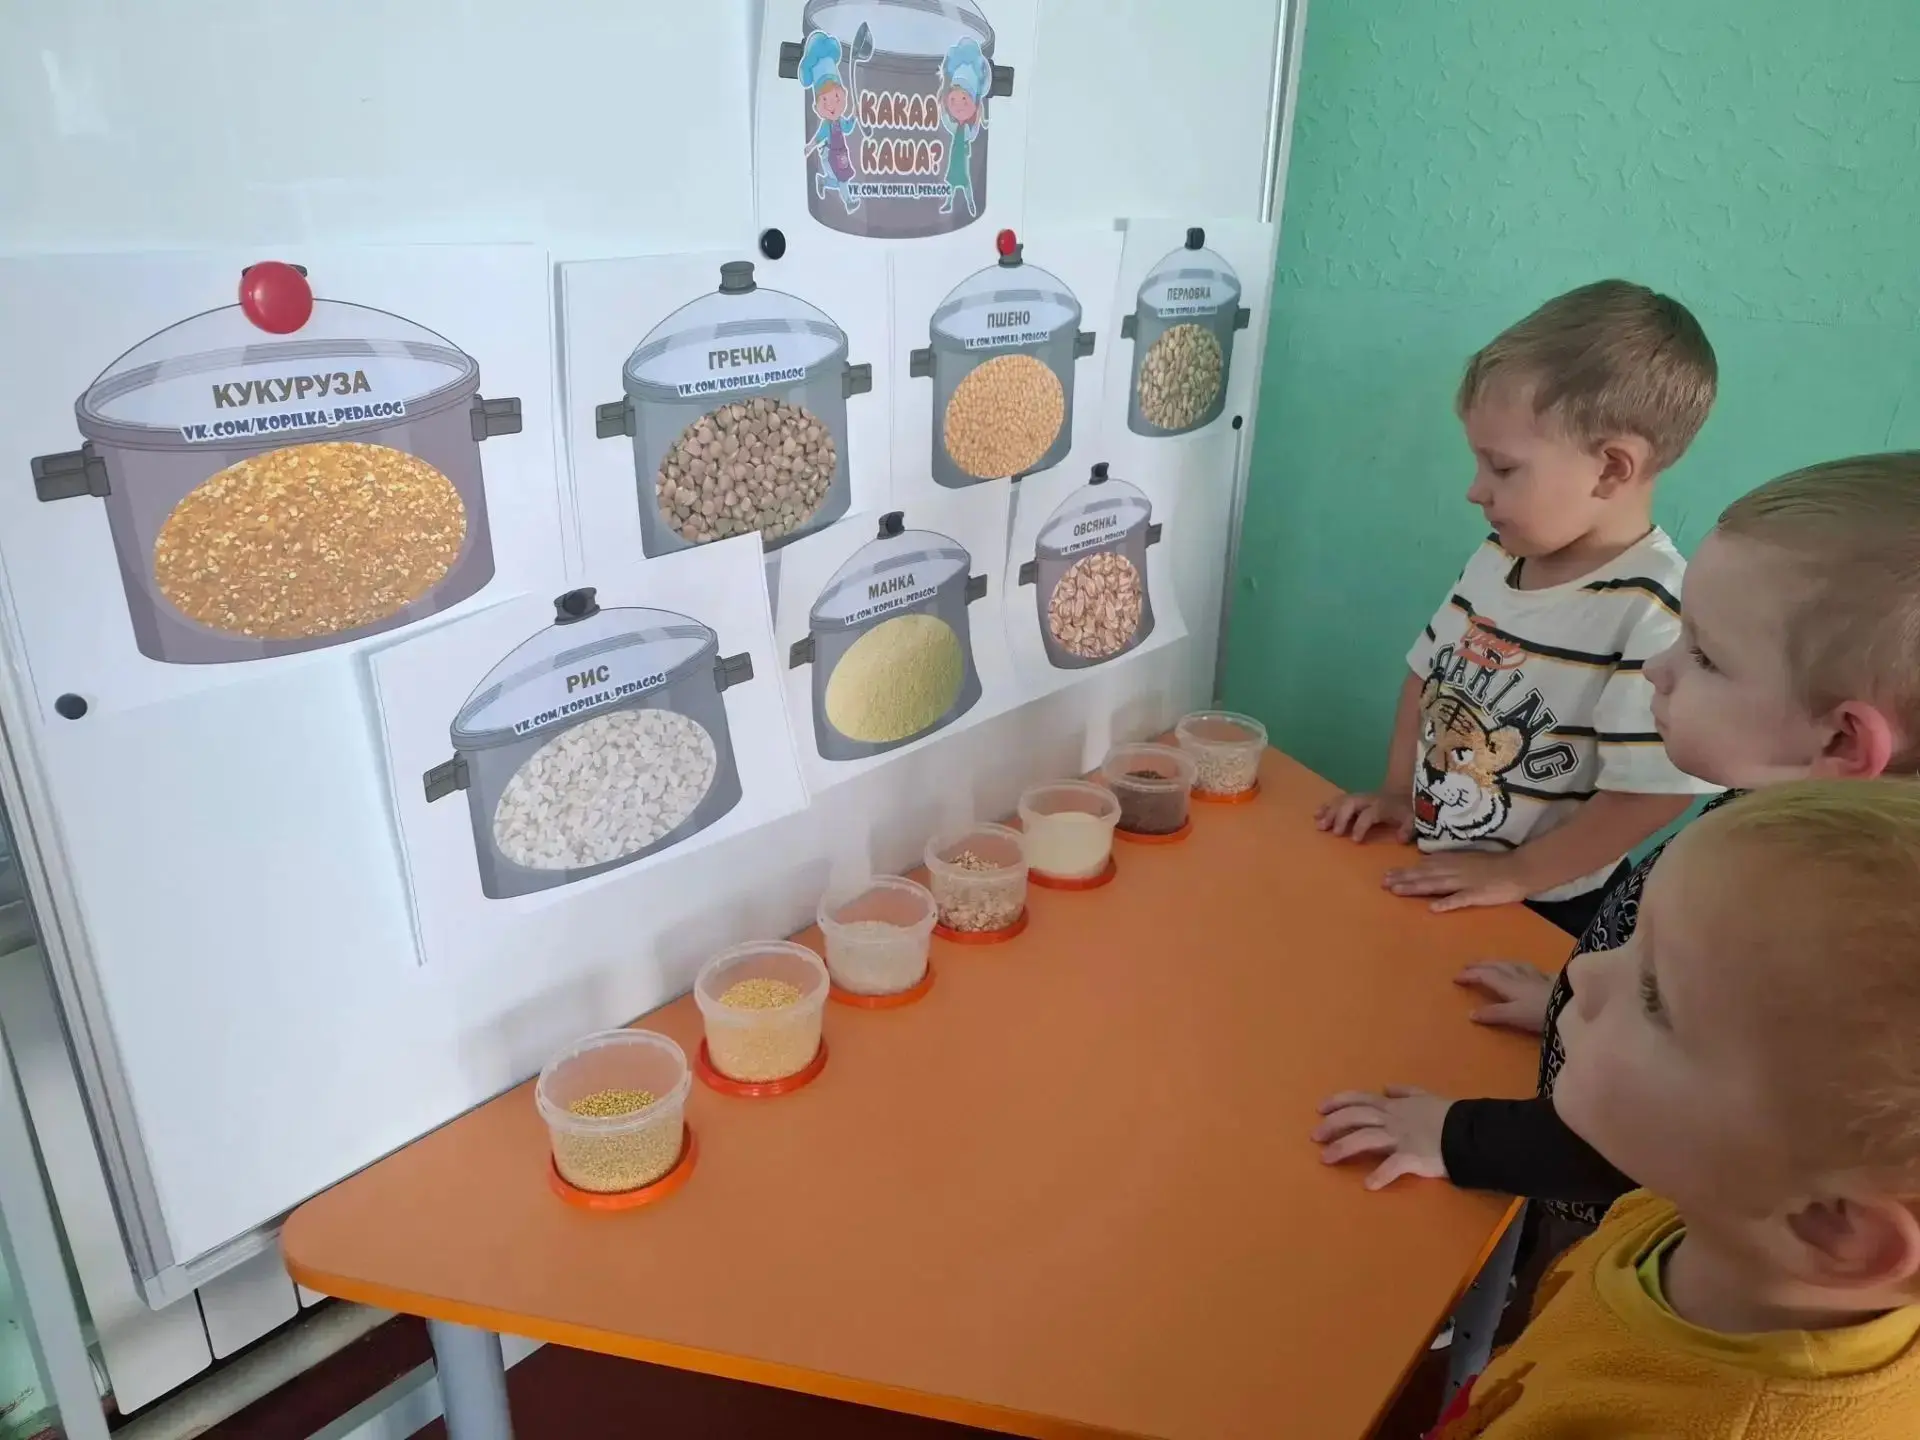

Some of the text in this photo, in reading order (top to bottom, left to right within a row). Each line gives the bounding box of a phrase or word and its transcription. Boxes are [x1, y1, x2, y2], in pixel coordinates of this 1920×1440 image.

[860, 91, 941, 129] КАКАЯ
[861, 138, 944, 175] КАША?
[1167, 286, 1211, 301] ПЕРЛОВКА
[987, 311, 1031, 329] ПШЕНО
[708, 344, 777, 370] ГРЕЧКА
[211, 370, 372, 409] КУКУРУЗА
[182, 401, 404, 441] VK.COM/KOPILKA_PEDAGOG
[1073, 514, 1118, 537] ОВСЯНКА
[868, 573, 915, 600] МАНКА
[565, 664, 611, 694] РИС
[514, 672, 666, 735] VK.COM/KOPILKA_PEDAGOG
